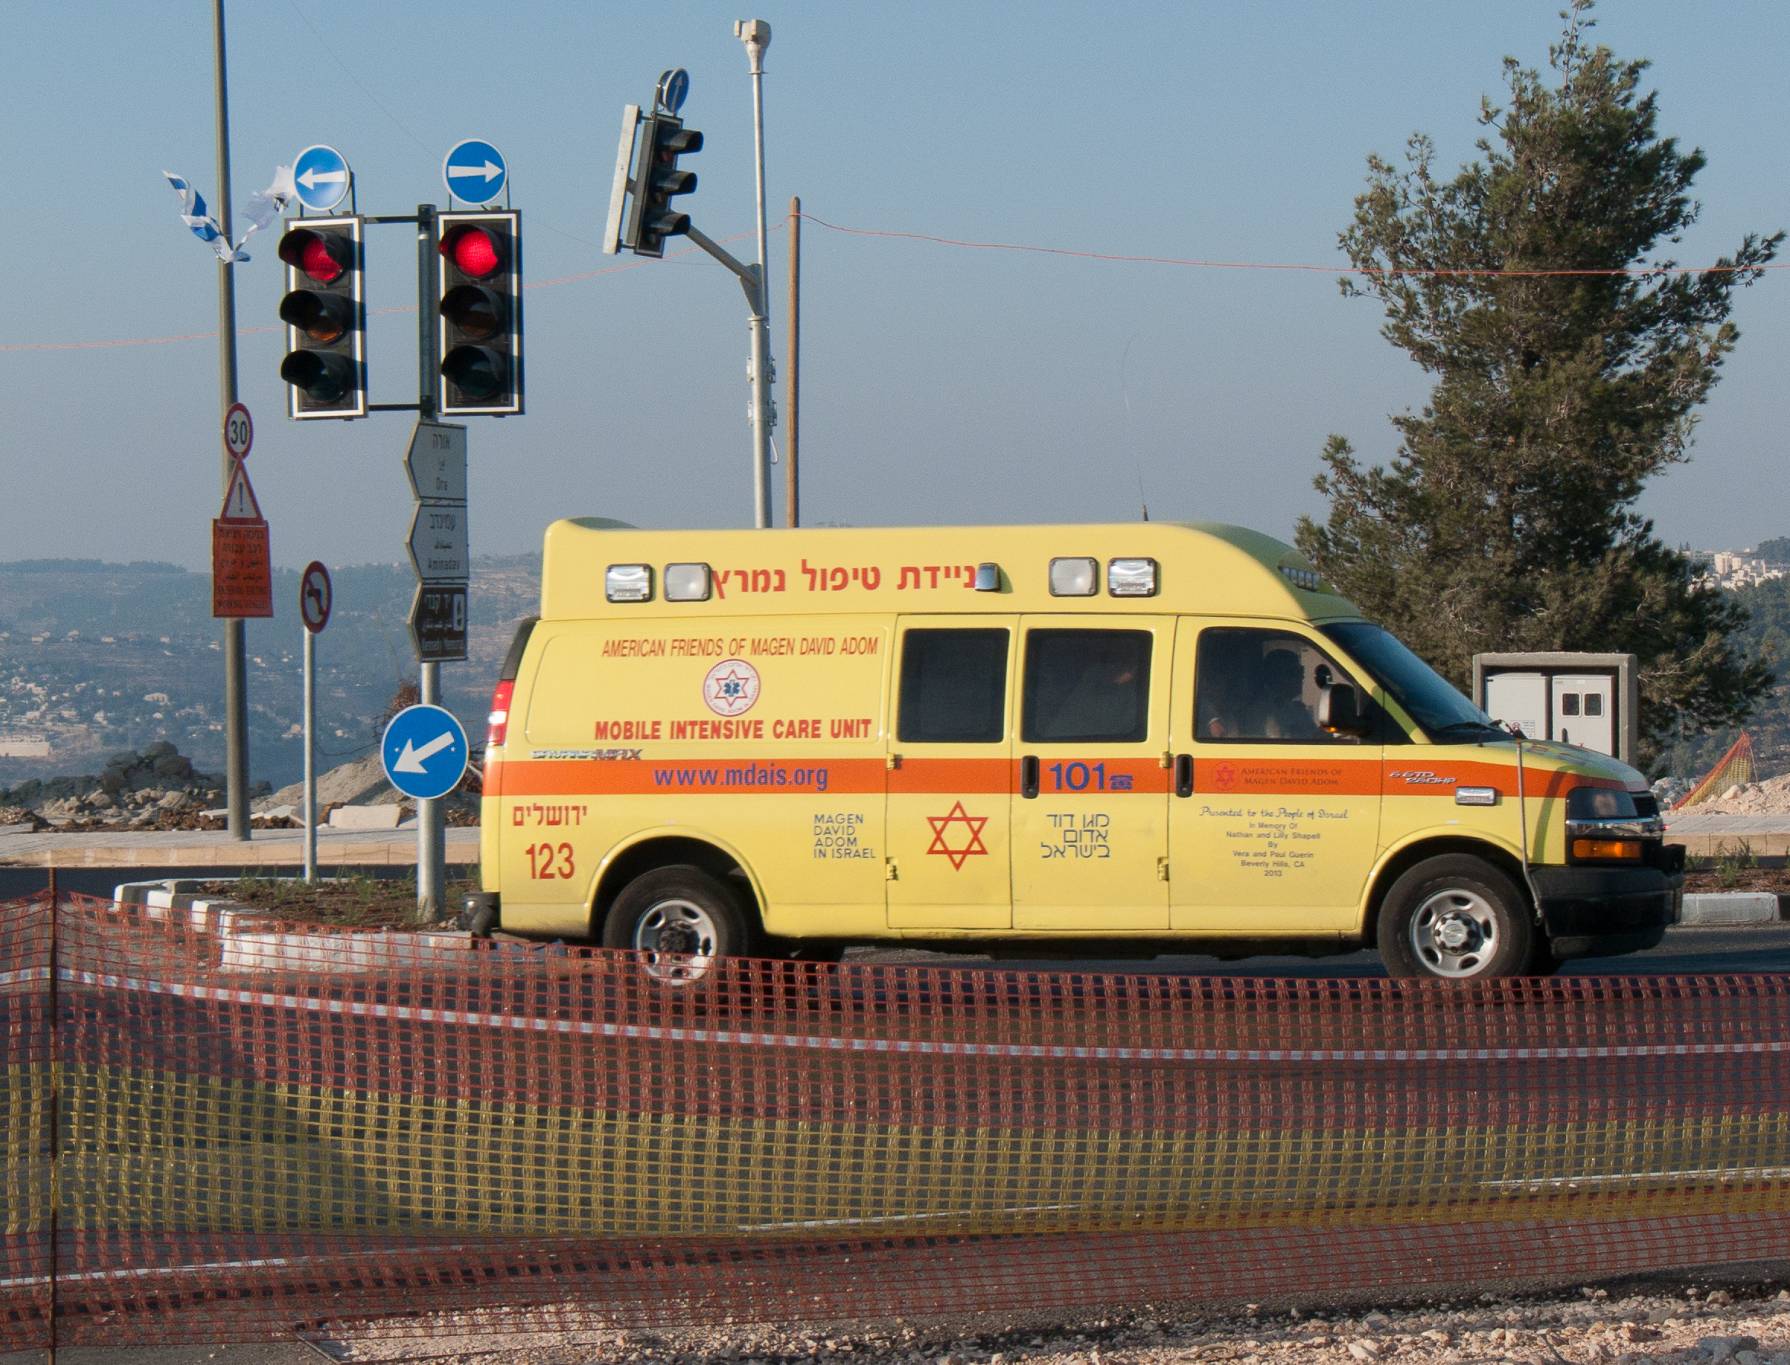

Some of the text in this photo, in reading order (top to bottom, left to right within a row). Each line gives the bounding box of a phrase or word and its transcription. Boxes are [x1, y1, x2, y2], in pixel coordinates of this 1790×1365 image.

[231, 420, 248, 445] 30
[711, 558, 977, 600] ניידת טיפול נמרץ
[602, 636, 878, 657] AMERICAN FRIENDS OF MAGEN DAVID ADOM
[594, 718, 872, 740] MOBILE INTENSIVE CARE UNIT
[654, 763, 829, 791] www.mdais.org
[1049, 762, 1106, 791] 101
[513, 803, 588, 827] ירושלים
[814, 813, 864, 824] MAGEN
[1046, 813, 1110, 828] מגן דוד
[814, 825, 856, 836] DAVID
[1258, 822, 1287, 831] Memory
[815, 836, 857, 848] ADOM
[1063, 829, 1109, 843] אדום
[1256, 831, 1271, 839] and
[1040, 842, 1110, 859] בישראל
[1267, 840, 1278, 849] By
[525, 842, 575, 879] 123
[814, 848, 877, 859] IN ISRAEL
[1252, 850, 1267, 858] and
[1269, 850, 1286, 858] Paul
[1240, 859, 1270, 869] Beverly
[1293, 860, 1305, 868] CA
